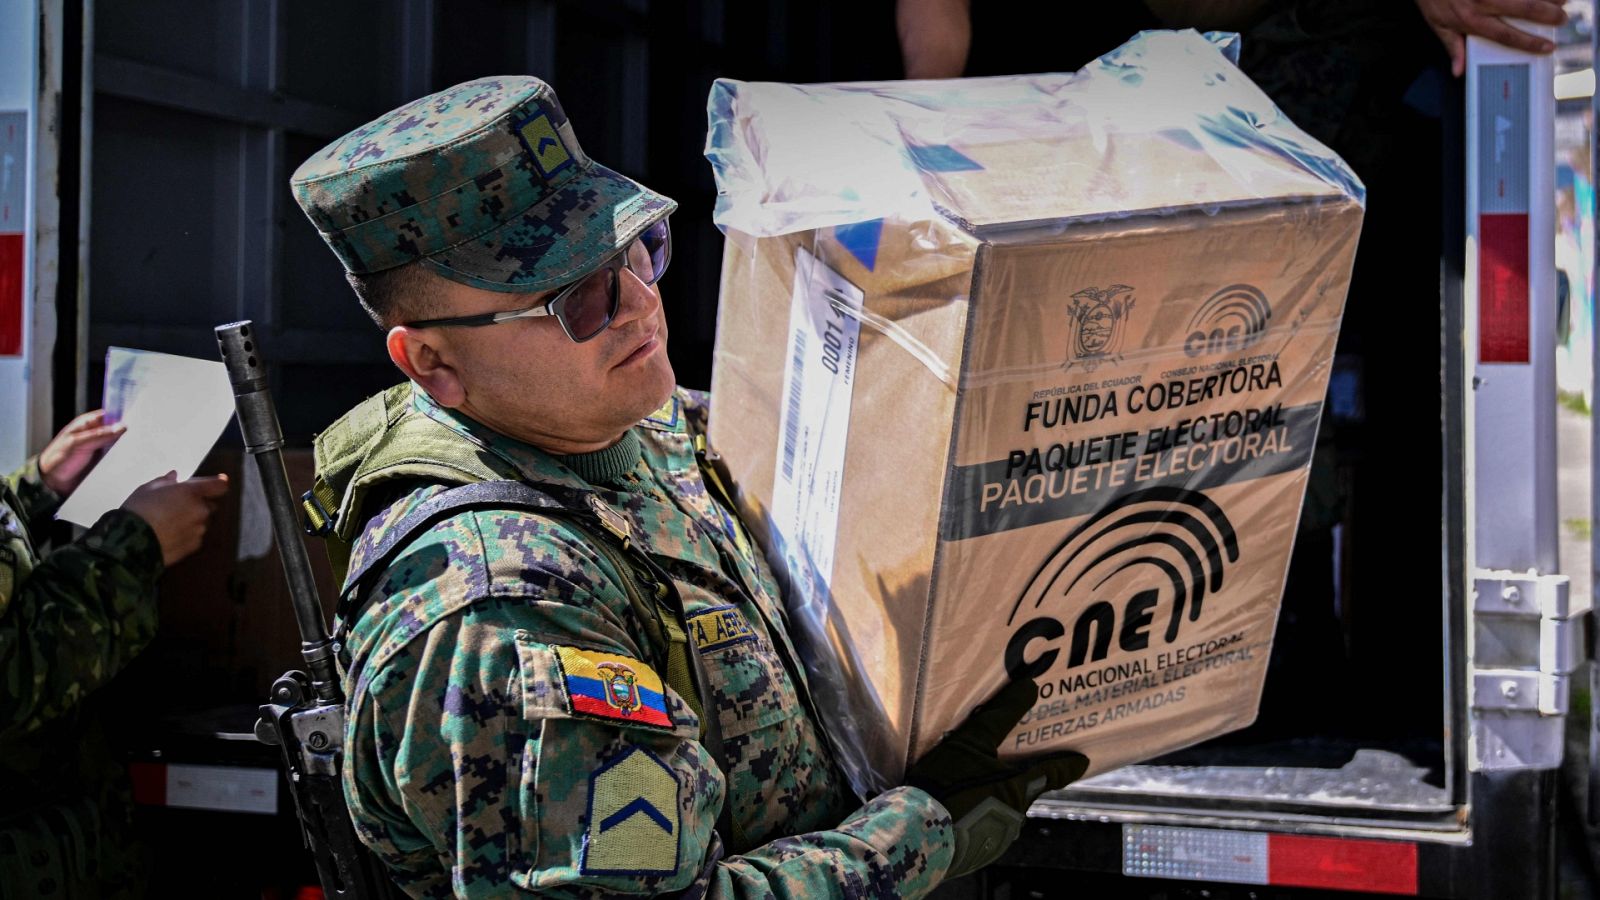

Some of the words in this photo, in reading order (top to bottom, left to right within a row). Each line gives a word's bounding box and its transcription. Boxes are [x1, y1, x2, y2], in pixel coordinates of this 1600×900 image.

[1024, 395, 1118, 431] FUNDA
[1127, 361, 1282, 413] COBERTORA
[1033, 383, 1082, 400] REPÚBLICA
[1083, 381, 1099, 394] DEL
[1101, 375, 1142, 389] ECUADOR
[1160, 366, 1197, 379] CONSEJO
[1199, 359, 1237, 373] NACIONAL
[1238, 353, 1281, 367] ELECTORAL
[980, 459, 1125, 512] PAQUETE
[1134, 427, 1292, 483] ELECTORAL
[1006, 431, 1138, 479] PAQUETE
[1145, 402, 1285, 454] ELECTORAL
[1060, 658, 1151, 695] NACIONAL
[1157, 631, 1244, 670] ELECTORAL
[1074, 669, 1159, 710] MATERIAL
[1163, 647, 1253, 684] ELECTORAL
[1015, 712, 1098, 750] FUERZAS
[1101, 685, 1186, 724] ARMADAS
